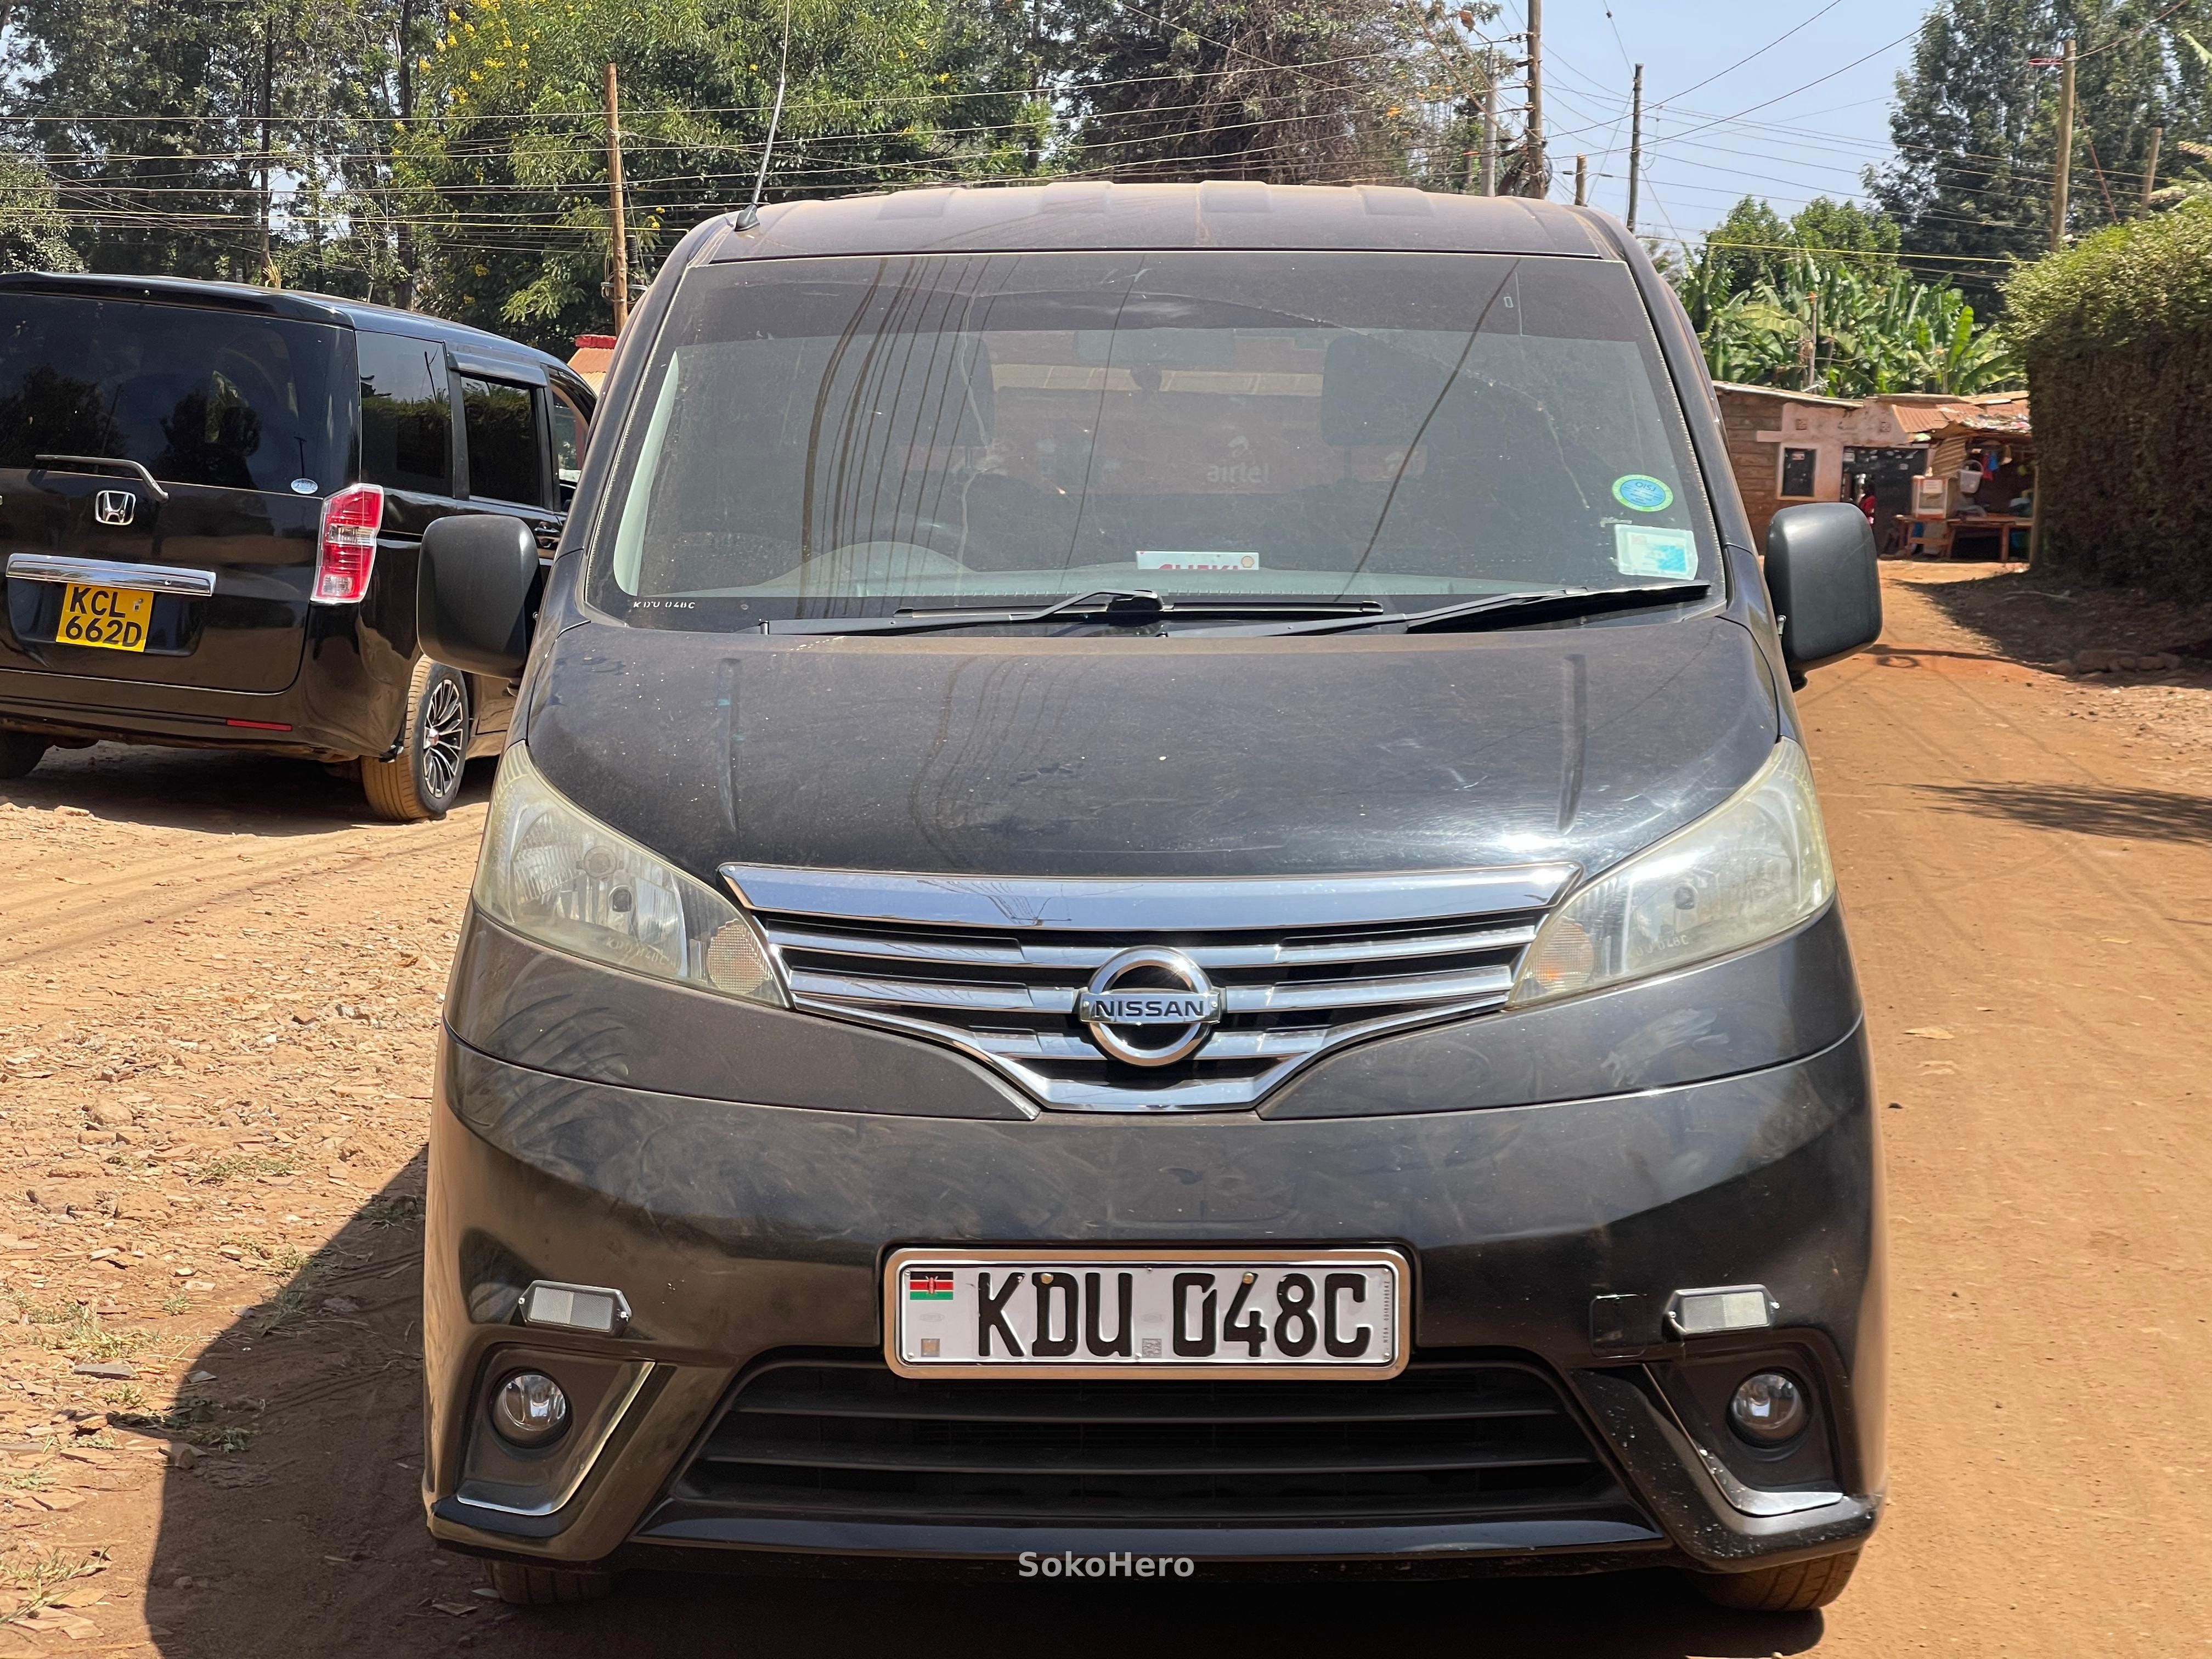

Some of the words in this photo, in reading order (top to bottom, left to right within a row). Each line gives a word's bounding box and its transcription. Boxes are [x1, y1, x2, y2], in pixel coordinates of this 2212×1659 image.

[70, 586, 126, 618] KCL
[65, 616, 142, 647] 662D
[1096, 1001, 1204, 1017] NISSAN
[977, 1272, 1133, 1357] KDU
[1172, 1272, 1371, 1357] 048C
